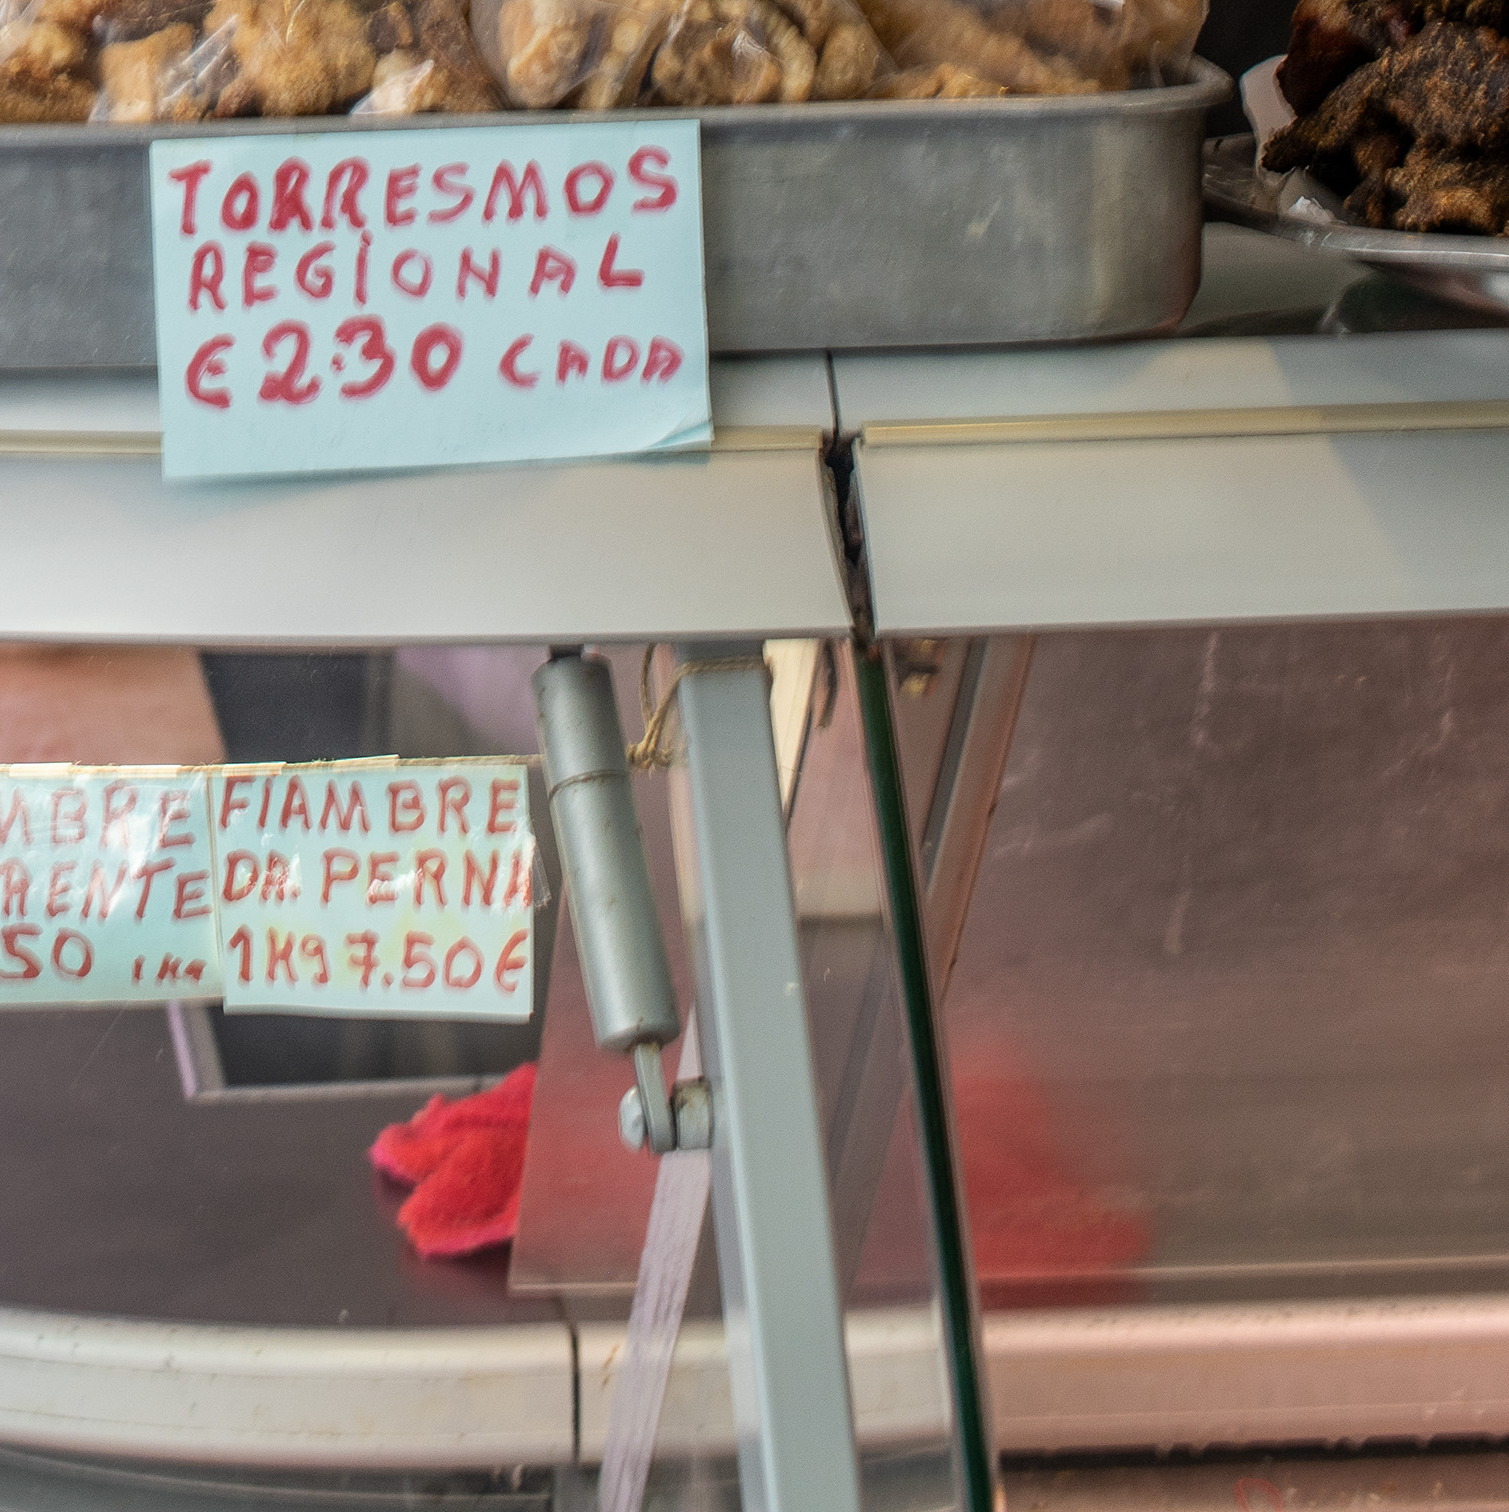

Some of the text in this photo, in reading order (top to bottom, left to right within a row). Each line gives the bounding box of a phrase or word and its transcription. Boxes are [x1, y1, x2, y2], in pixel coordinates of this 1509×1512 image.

[167, 144, 681, 237] TORRESMOS
[499, 331, 686, 389] CADA
[218, 773, 522, 835] FIAMBRE
[320, 846, 534, 910] PERNA
